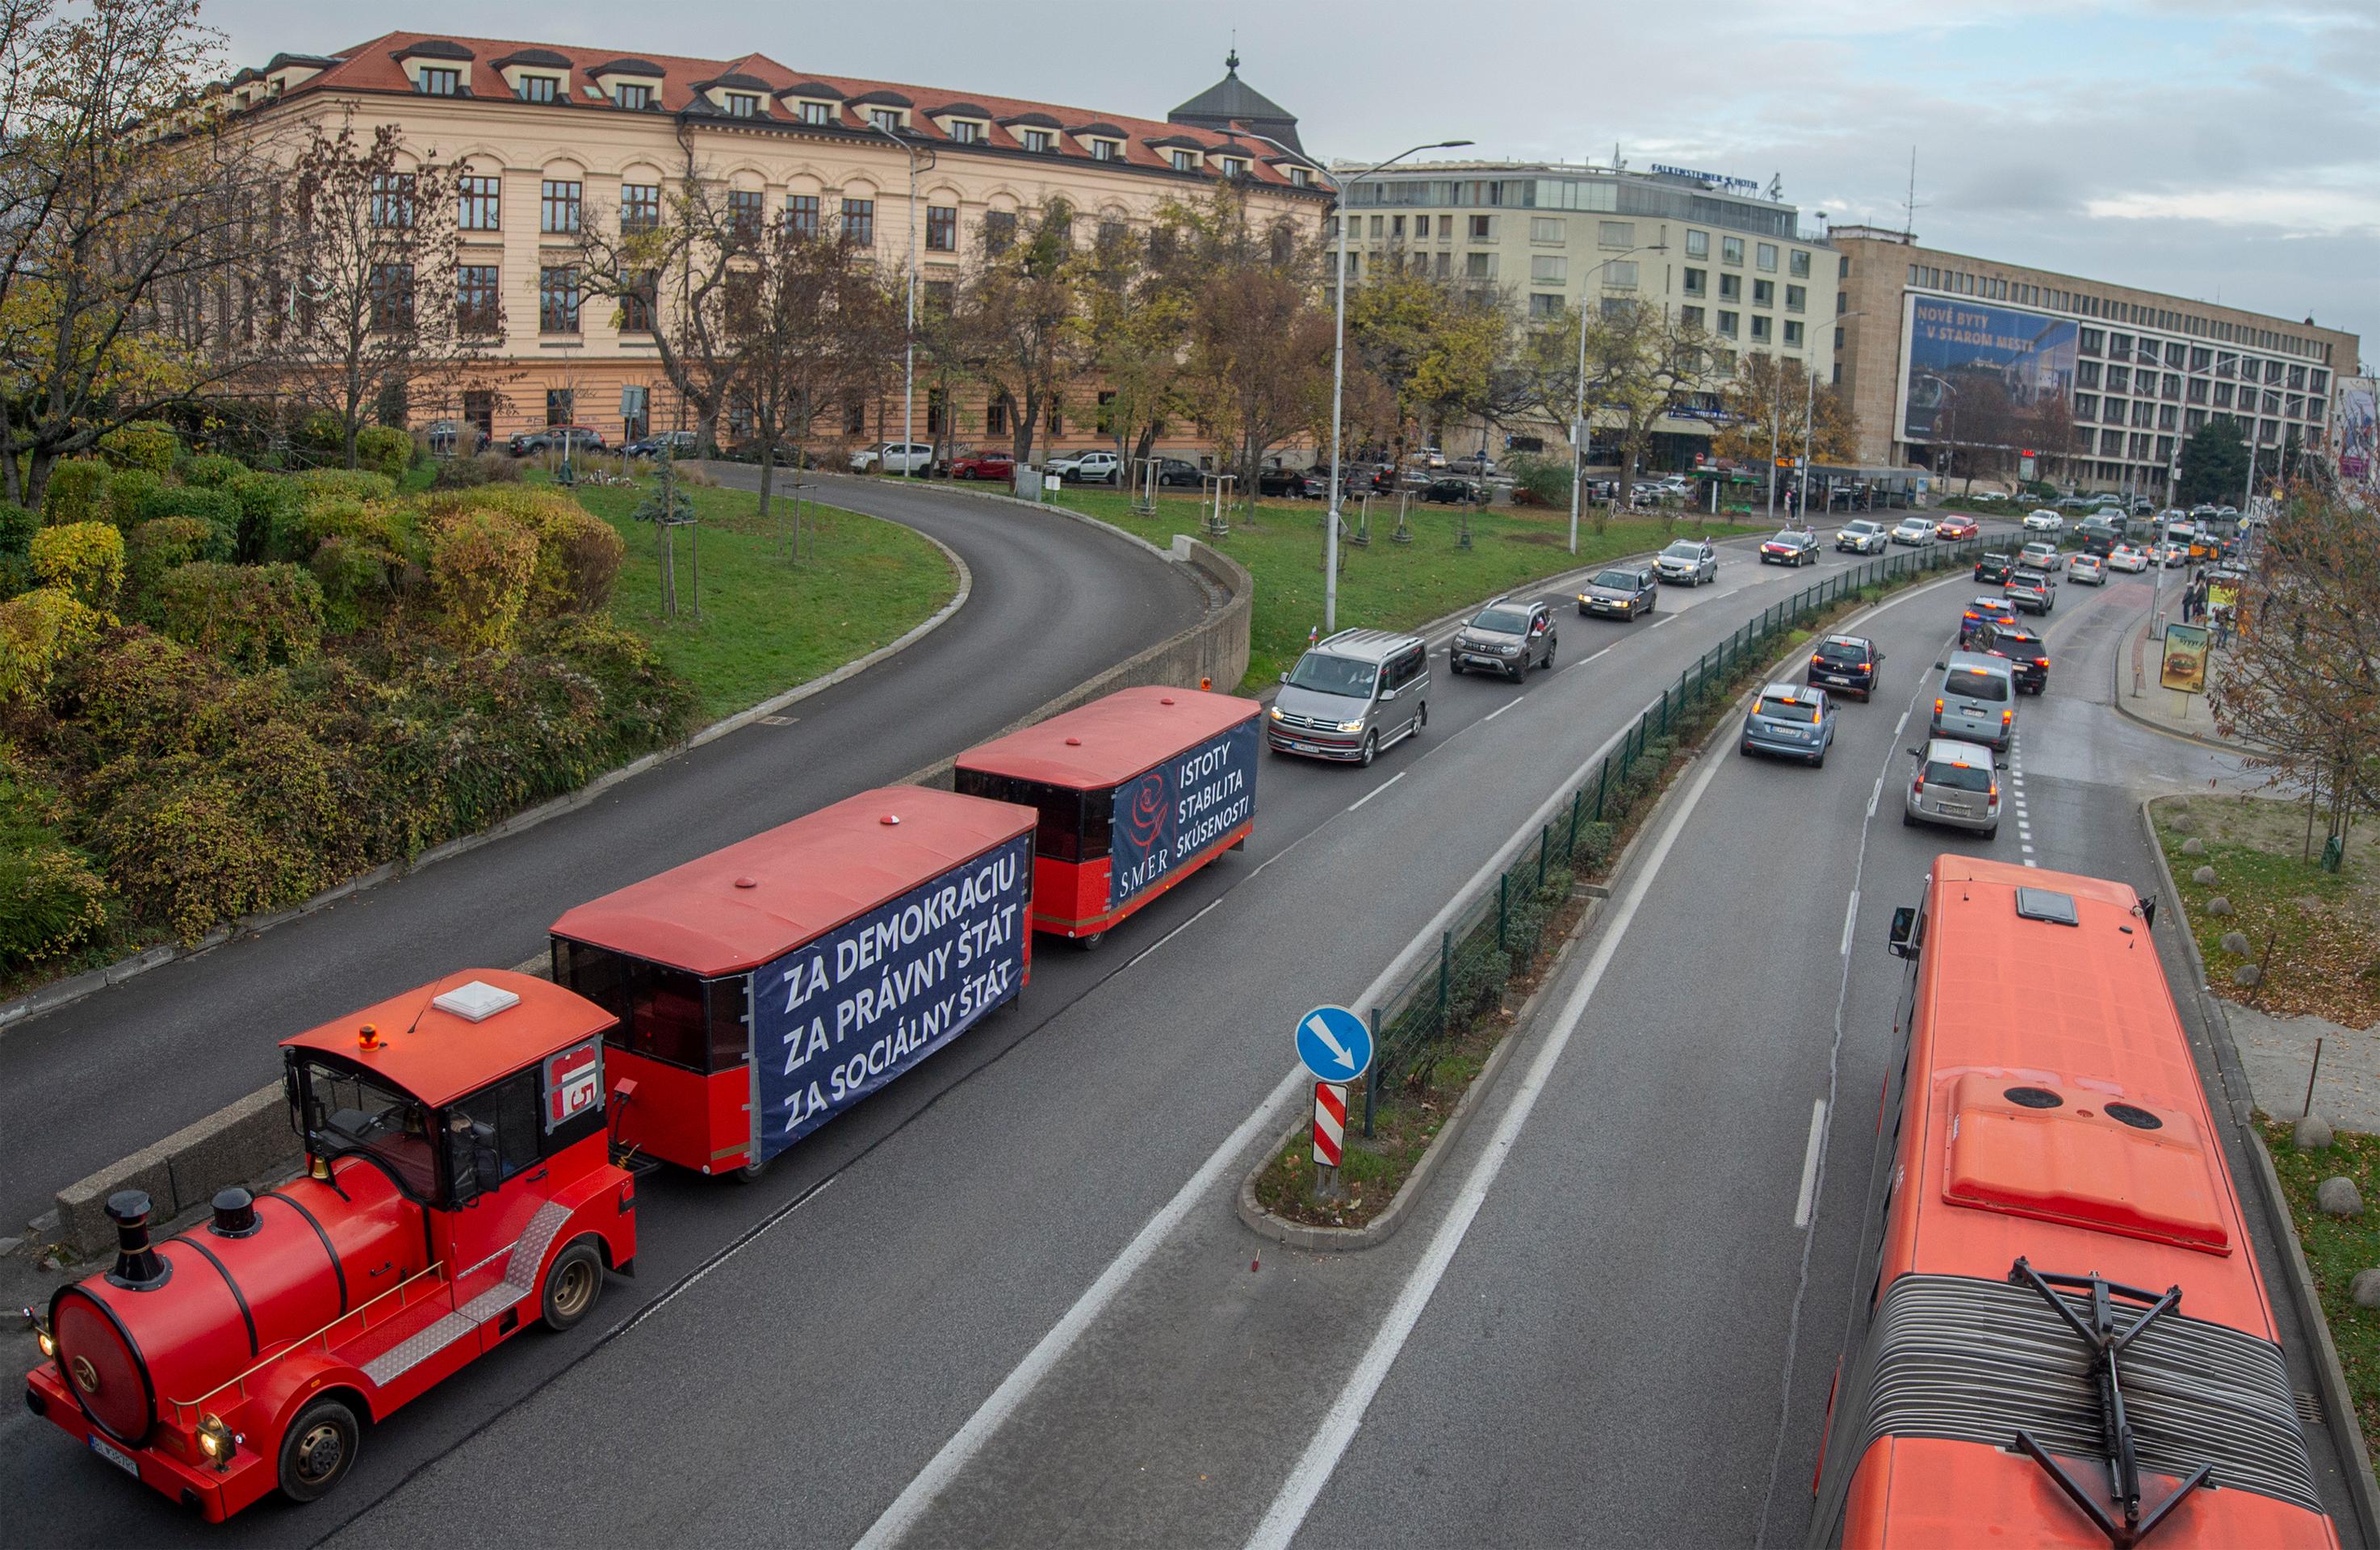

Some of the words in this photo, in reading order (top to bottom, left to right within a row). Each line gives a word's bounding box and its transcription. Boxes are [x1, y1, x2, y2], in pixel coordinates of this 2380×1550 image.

[1652, 163, 1722, 182] FALKENSTEINER
[1734, 178, 1758, 189] HOTEL
[1917, 306, 1953, 323] NOVÉ
[1957, 312, 1989, 329] BYTY
[1927, 325, 1935, 338] V
[1939, 328, 1992, 347] STAROM
[1997, 336, 2034, 354] MESTE
[1180, 741, 1230, 789] ISTOTY
[1179, 769, 1243, 824] STABILITA
[1177, 795, 1249, 858] SKÚSENOSTI
[1120, 848, 1168, 898] SMER
[784, 955, 830, 1014] ZA
[836, 852, 1016, 983] DEMOKRACIU
[784, 1014, 830, 1076] ZA
[836, 940, 953, 1043] PRÁVNY
[958, 903, 1016, 969] ŠTÁT
[784, 1080, 828, 1133] ZA
[831, 993, 957, 1102] SOCIÁLNY
[960, 958, 1012, 1016] ŠTÁT
